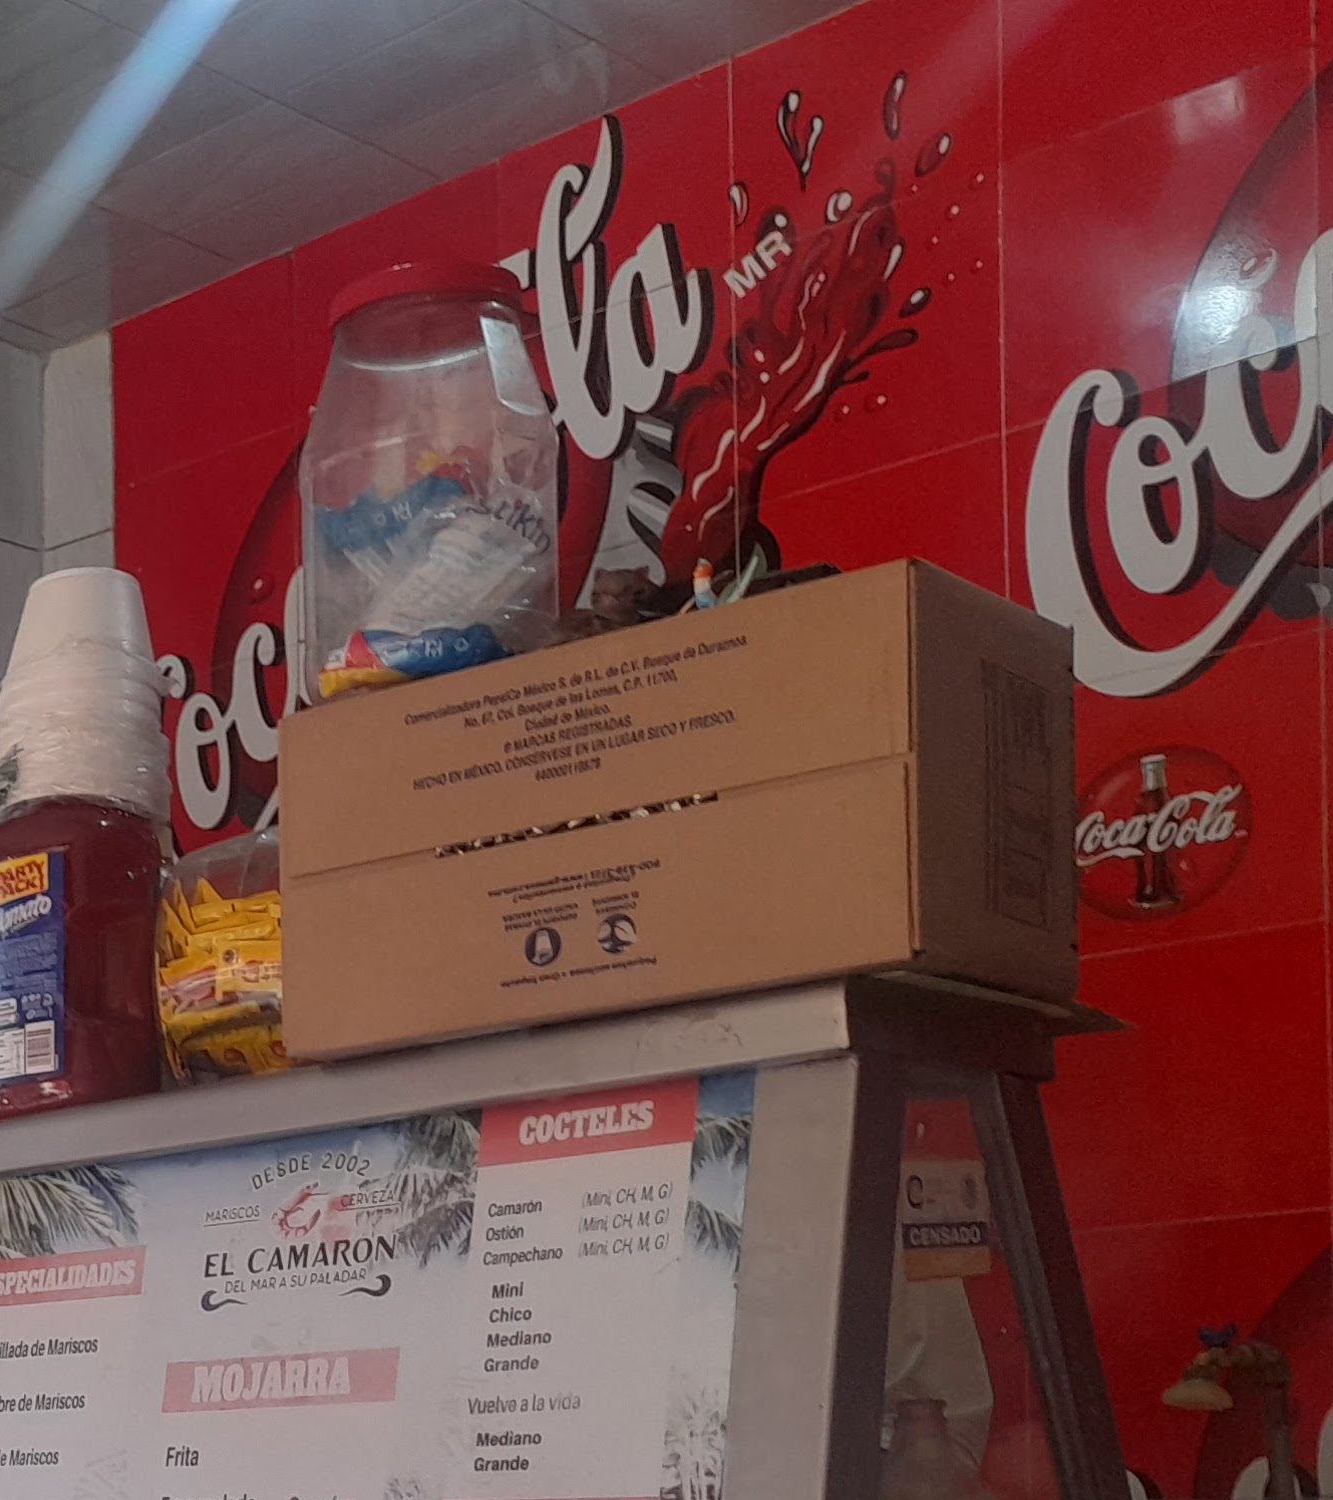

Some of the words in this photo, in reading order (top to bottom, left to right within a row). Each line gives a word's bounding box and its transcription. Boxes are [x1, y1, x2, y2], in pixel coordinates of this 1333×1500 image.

[723, 230, 793, 300] MR
[519, 1099, 655, 1147] COCTELES
[250, 1153, 312, 1191] DESDE
[321, 1151, 371, 1178] 2002
[204, 1204, 261, 1223] MARISCOS
[339, 1189, 396, 1209] CERVEZA
[487, 1199, 543, 1219] Camarón
[485, 1223, 525, 1243] Ostión
[909, 1223, 982, 1248] CENSADO
[203, 1252, 235, 1279] EL
[247, 1233, 398, 1275] CAMARON
[482, 1245, 564, 1268] Campechano
[223, 1279, 247, 1295] DEL
[249, 1276, 277, 1291] MAR
[277, 1275, 288, 1288] A
[289, 1273, 308, 1288] SU
[309, 1267, 367, 1286] PALADAR
[491, 1281, 525, 1300] Mini
[487, 1306, 533, 1325] Chico
[30, 1338, 46, 1358] de
[46, 1336, 99, 1357] Mariscos
[485, 1329, 553, 1350] Mediano
[482, 1355, 540, 1374] Grande
[189, 1356, 351, 1405] MOJARRA
[17, 1394, 33, 1413] de
[34, 1392, 86, 1412] Mariscos
[466, 1395, 518, 1416] Vuelve
[519, 1398, 529, 1413] a
[531, 1393, 546, 1413] la
[475, 1430, 543, 1449] Mediano
[8, 1448, 60, 1467] Mariscos
[164, 1445, 200, 1470] Frita
[472, 1456, 531, 1473] Grande
